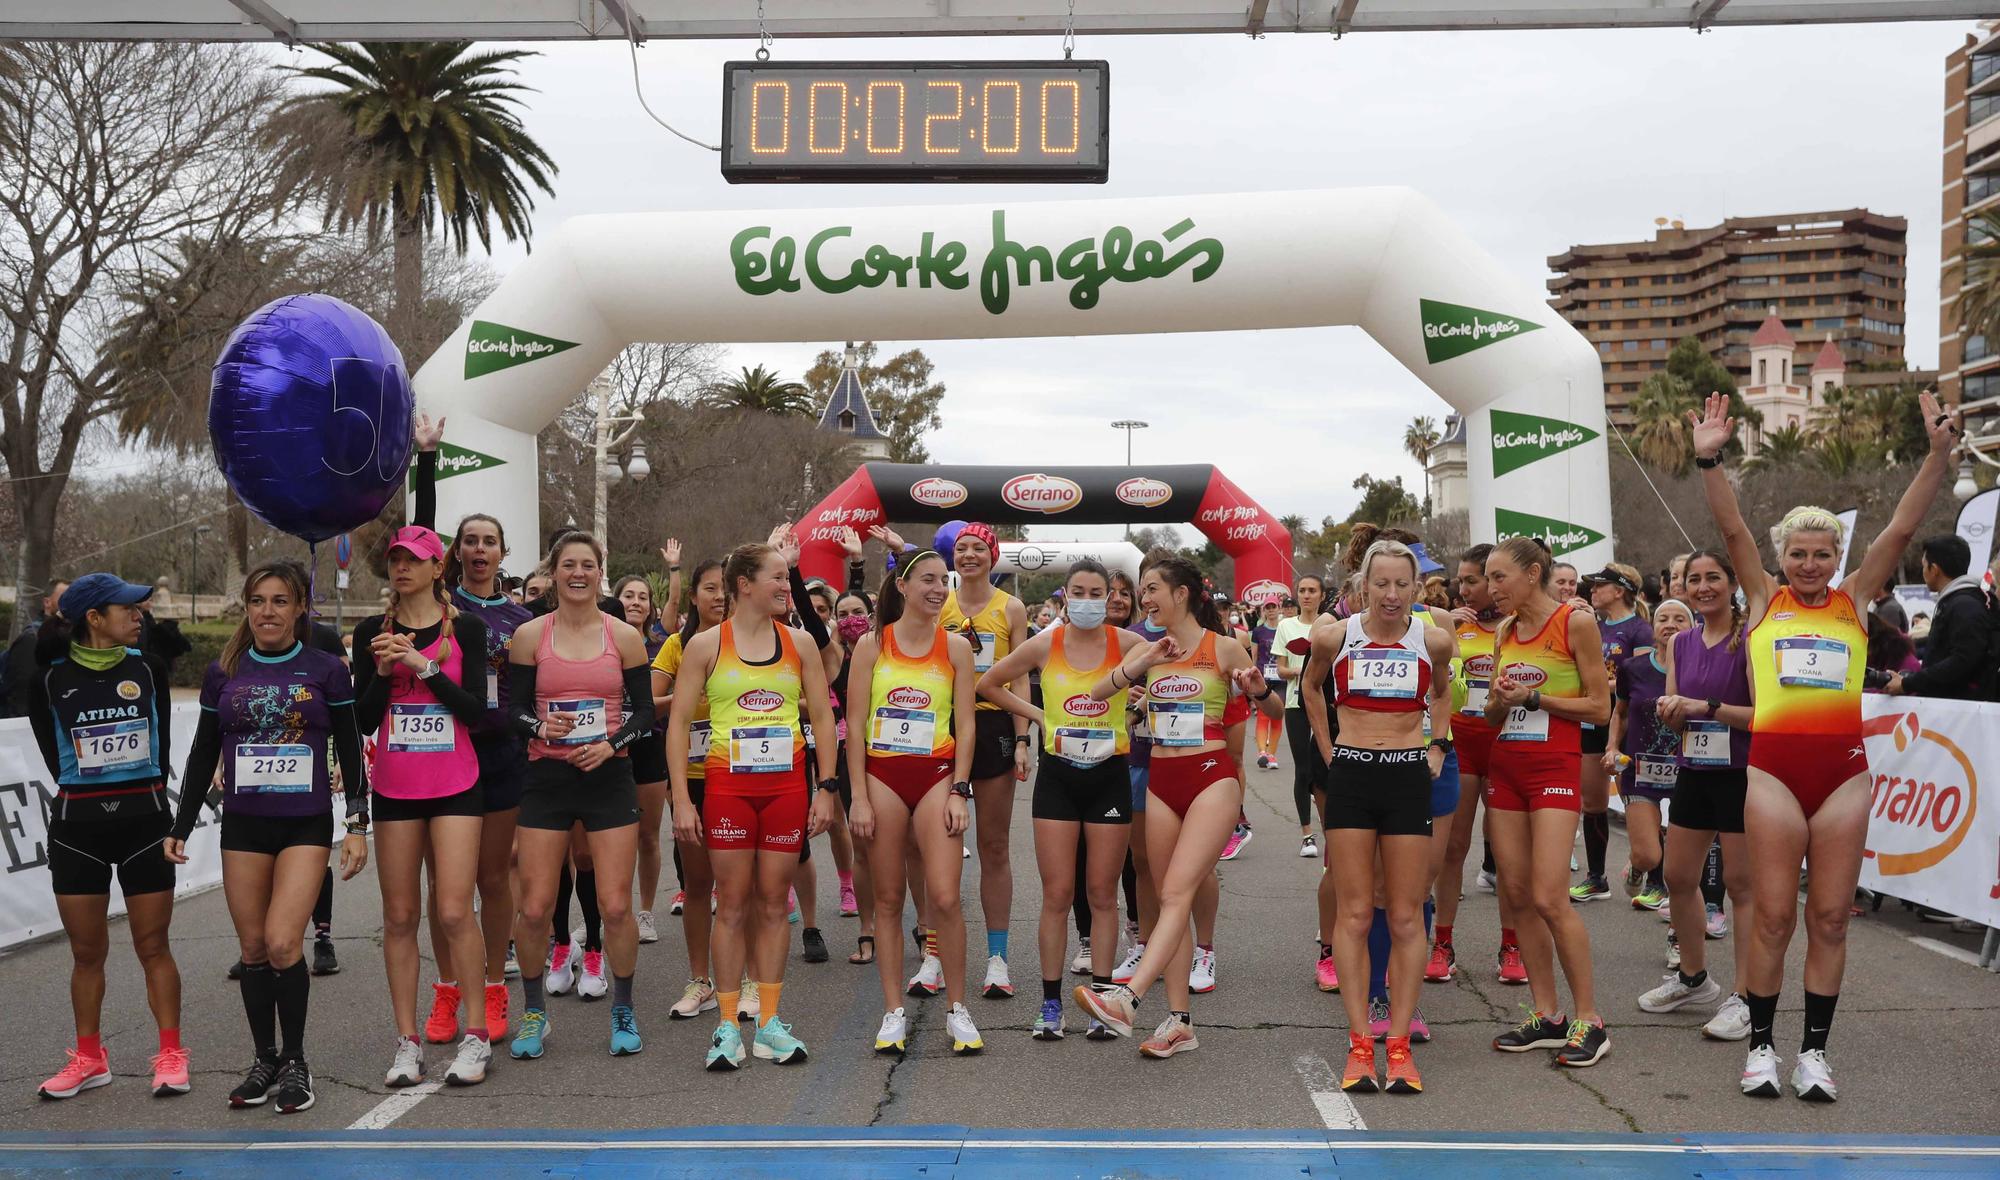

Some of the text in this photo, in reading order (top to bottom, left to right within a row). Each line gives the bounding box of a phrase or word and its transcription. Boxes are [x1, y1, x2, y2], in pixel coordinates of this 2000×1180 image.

[751, 80, 1079, 154] 00:02:00
[730, 226, 801, 296] El
[805, 226, 970, 295] Corte
[1424, 322, 1438, 338] El
[1438, 321, 1472, 337] Corte
[468, 339, 480, 354] El
[480, 338, 509, 353] Corte
[321, 356, 413, 482] 50
[1493, 432, 1507, 449] El
[1507, 430, 1538, 445] Corte
[915, 485, 963, 501] Serrano
[1009, 483, 1075, 503] Serrano
[1119, 484, 1167, 500] Serrano
[819, 506, 880, 524] COME BIEN
[1202, 505, 1259, 524] COME BIEN
[1021, 554, 1042, 562] MINI
[1467, 660, 1494, 672] Serra
[1806, 652, 1818, 666] 3
[1362, 661, 1408, 679] 1343
[1508, 671, 1543, 682] errano
[1797, 668, 1823, 676] YOANA
[1153, 683, 1198, 694] Serrano
[742, 695, 781, 706] Serrano
[890, 692, 929, 705] Serrano
[1067, 700, 1106, 711] Serrano
[76, 704, 139, 723] ATIPAQ
[1511, 709, 1527, 722] 10
[400, 716, 445, 733] 1356
[899, 722, 910, 735] 9
[1170, 715, 1178, 728] 7
[89, 733, 139, 755] 1676
[760, 740, 769, 754] 5
[1082, 741, 1089, 754] 1
[1694, 734, 1708, 747] 13
[1337, 748, 1374, 762] PRO
[1379, 750, 1419, 763] NIKE
[253, 758, 298, 774] 2132
[1646, 763, 1681, 777] 1326
[711, 828, 747, 836] SERRANO
